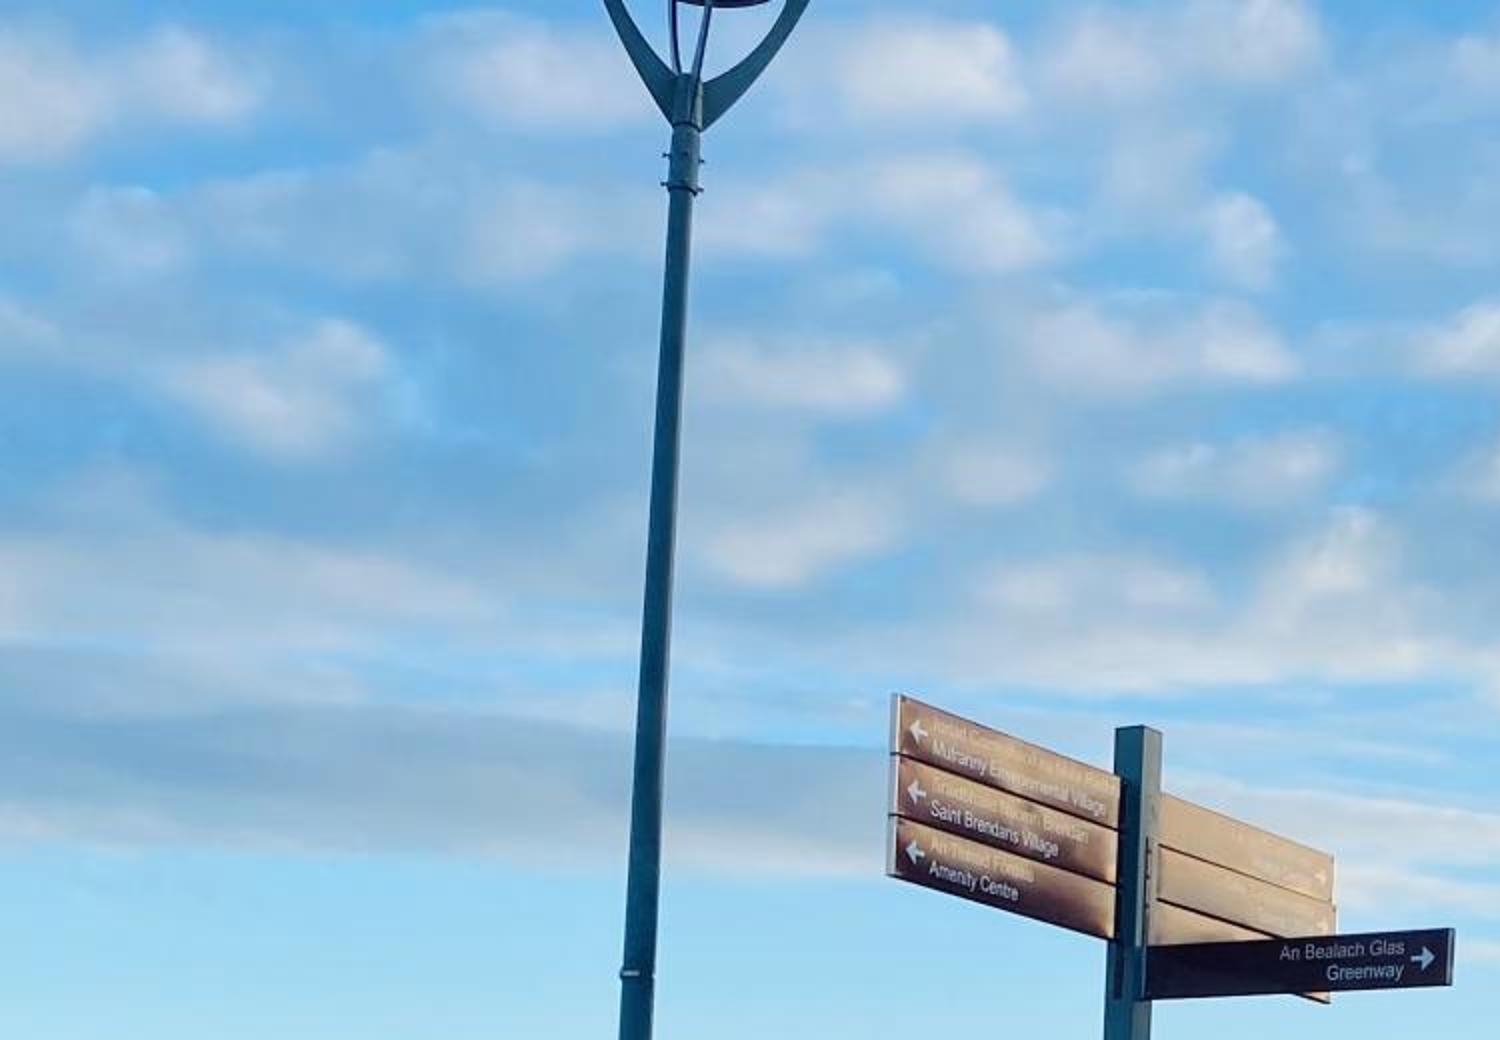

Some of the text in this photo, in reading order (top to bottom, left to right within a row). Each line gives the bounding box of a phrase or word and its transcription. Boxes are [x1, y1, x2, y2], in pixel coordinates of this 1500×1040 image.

[931, 799, 961, 824] Saint
[965, 811, 1019, 843] Brendans
[1021, 830, 1058, 858] Village
[929, 860, 976, 891] Amenity
[980, 875, 1018, 901] Centre
[1279, 939, 1405, 960] An Bealach Glas
[1326, 963, 1404, 981] Greenway
